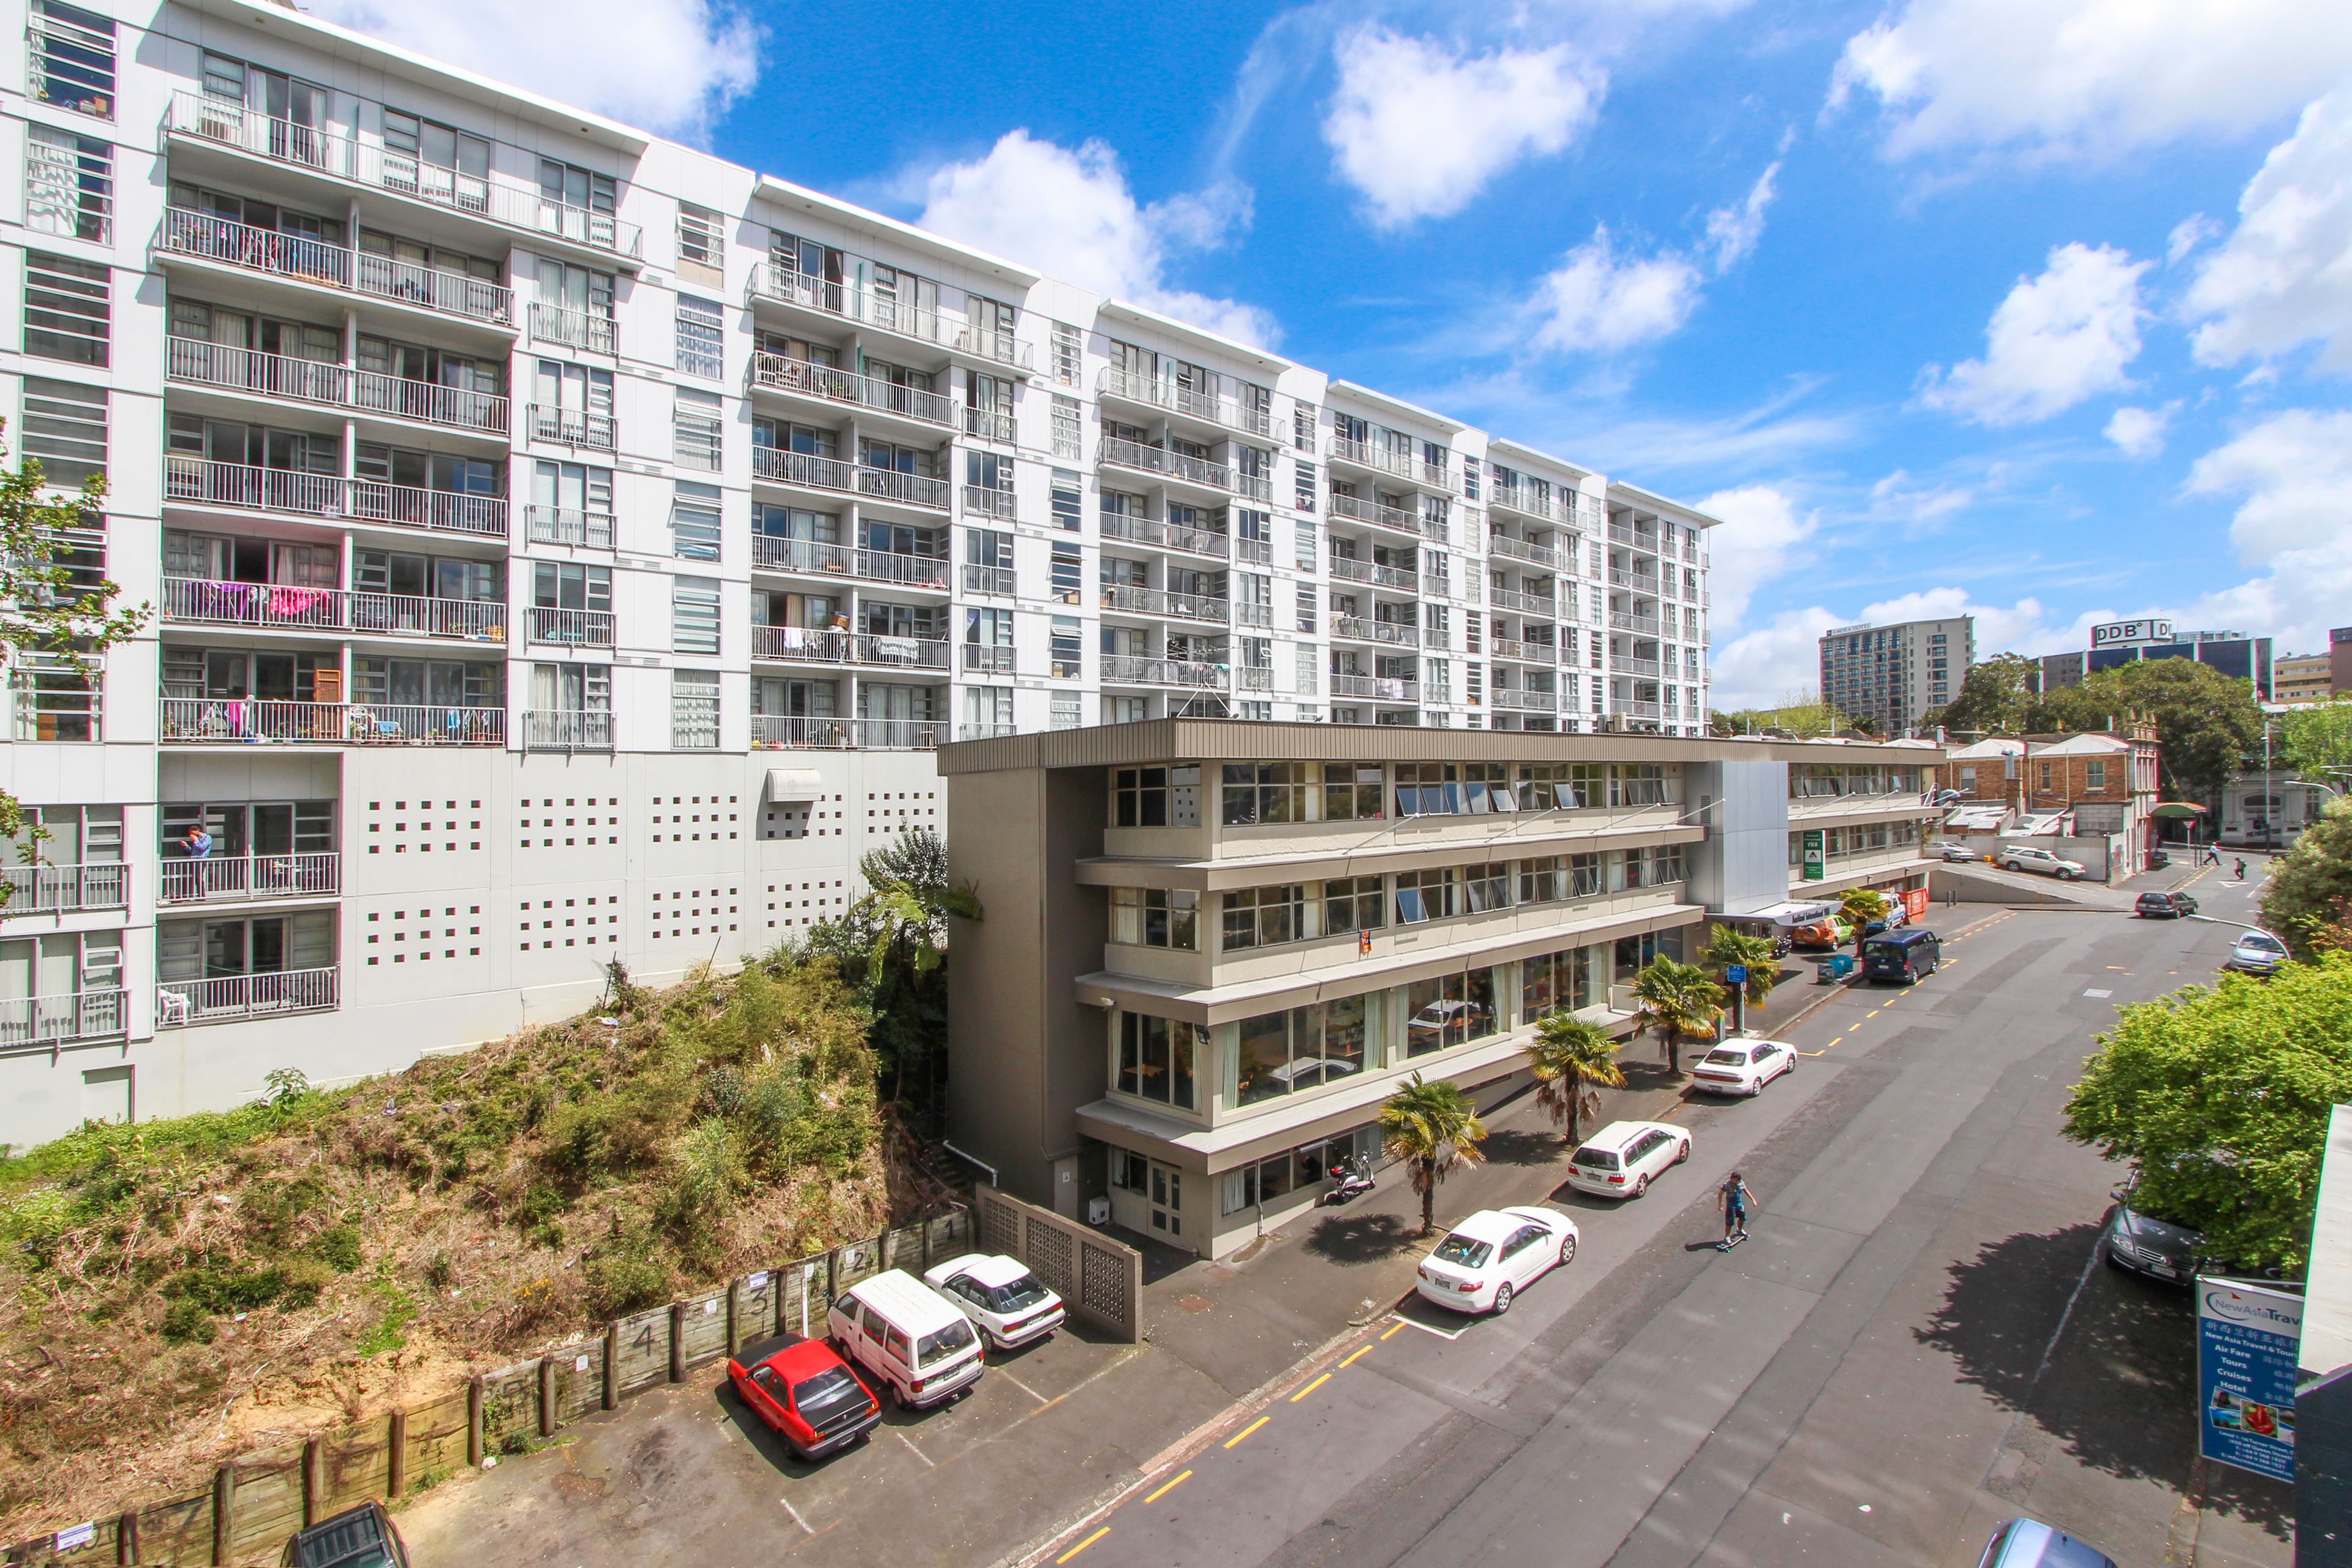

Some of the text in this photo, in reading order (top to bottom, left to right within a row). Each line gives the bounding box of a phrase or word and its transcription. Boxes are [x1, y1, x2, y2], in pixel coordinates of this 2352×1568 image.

[1852, 623, 1871, 631] HOTEL
[2098, 625, 2136, 641] DDB
[852, 1252, 865, 1273] 2
[750, 1287, 767, 1315] 3
[632, 1324, 655, 1357] 4
[2206, 1331, 2223, 1340] New
[2224, 1336, 2241, 1344] Asia
[2242, 1340, 2267, 1351] Travel
[2230, 1348, 2251, 1359] Fare
[2221, 1357, 2247, 1368] Tours
[2217, 1368, 2251, 1382] Cruises
[2220, 1381, 2247, 1392] Hotel
